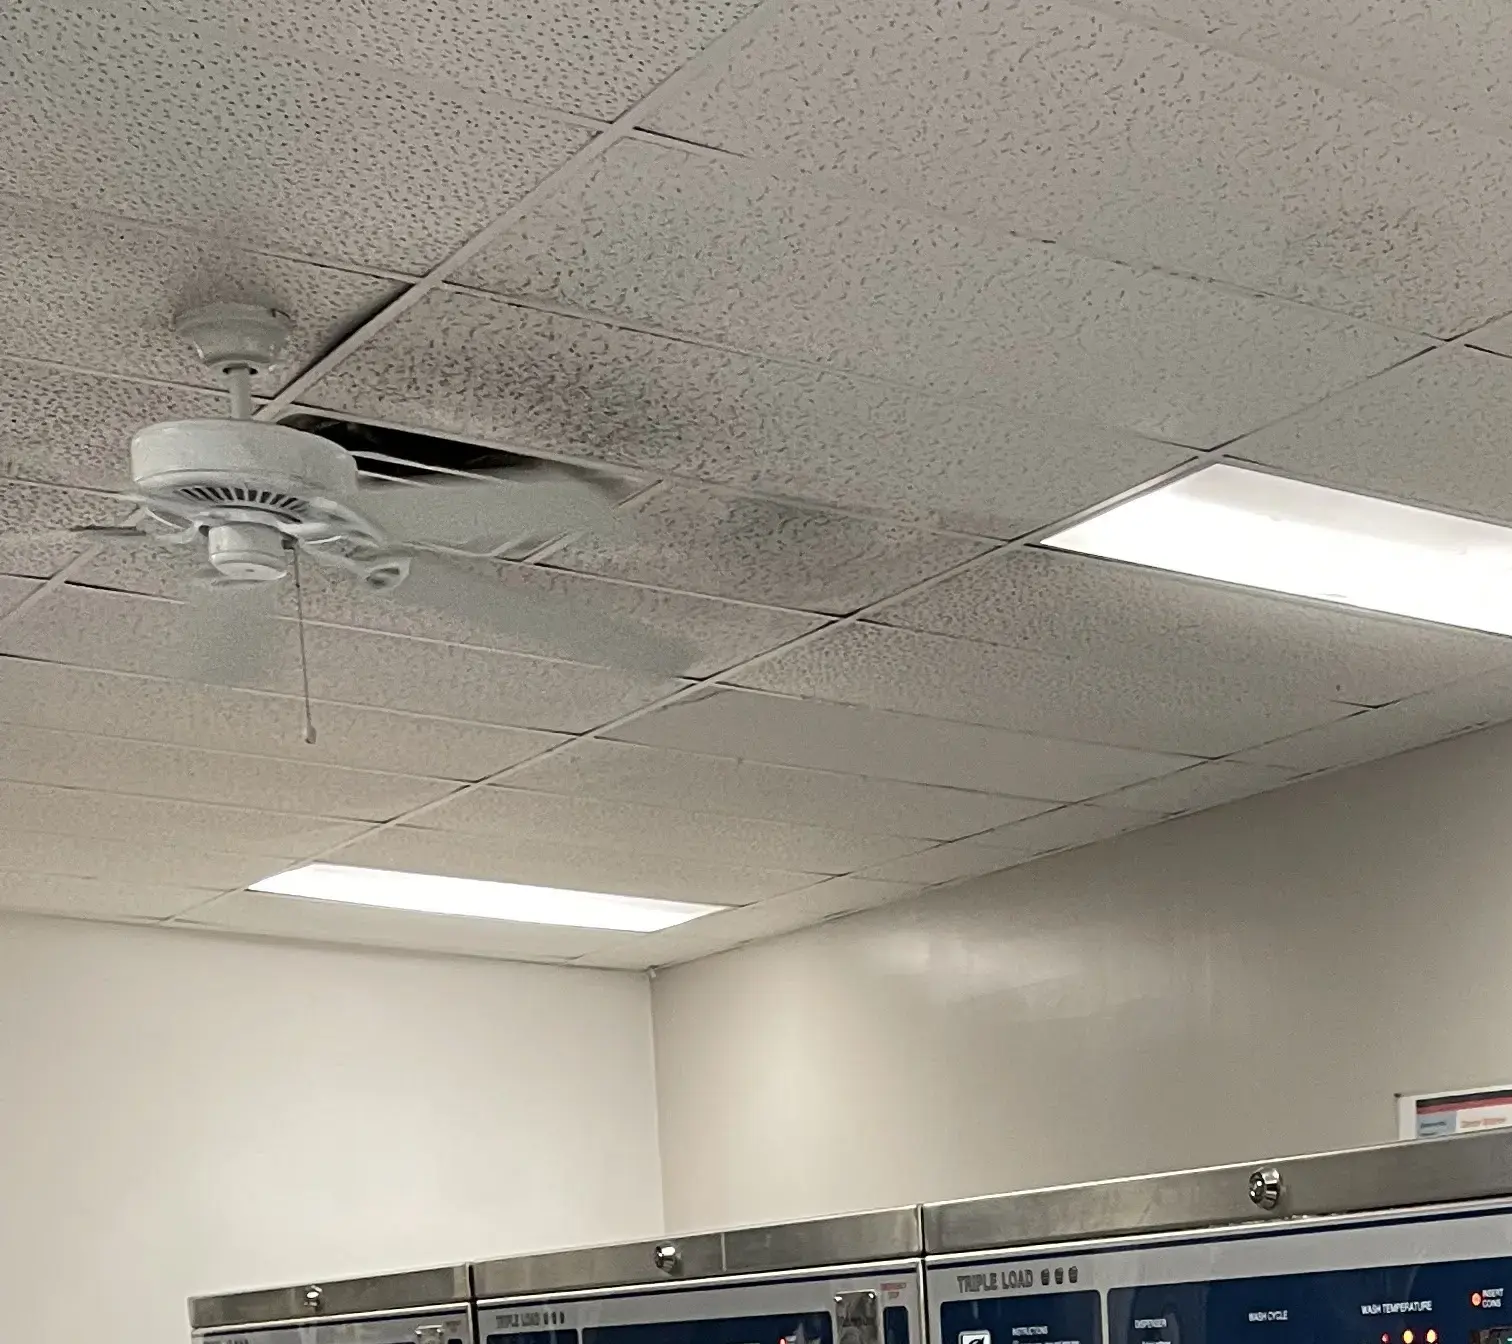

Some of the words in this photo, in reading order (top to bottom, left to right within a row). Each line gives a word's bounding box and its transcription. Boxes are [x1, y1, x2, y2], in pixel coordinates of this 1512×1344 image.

[957, 1273, 998, 1293] TRIPLE
[1001, 1269, 1033, 1290] LOAD
[1267, 1310, 1288, 1320] CYCLE
[1361, 1304, 1381, 1315] WASH
[1382, 1300, 1433, 1314] TEMPERATURE
